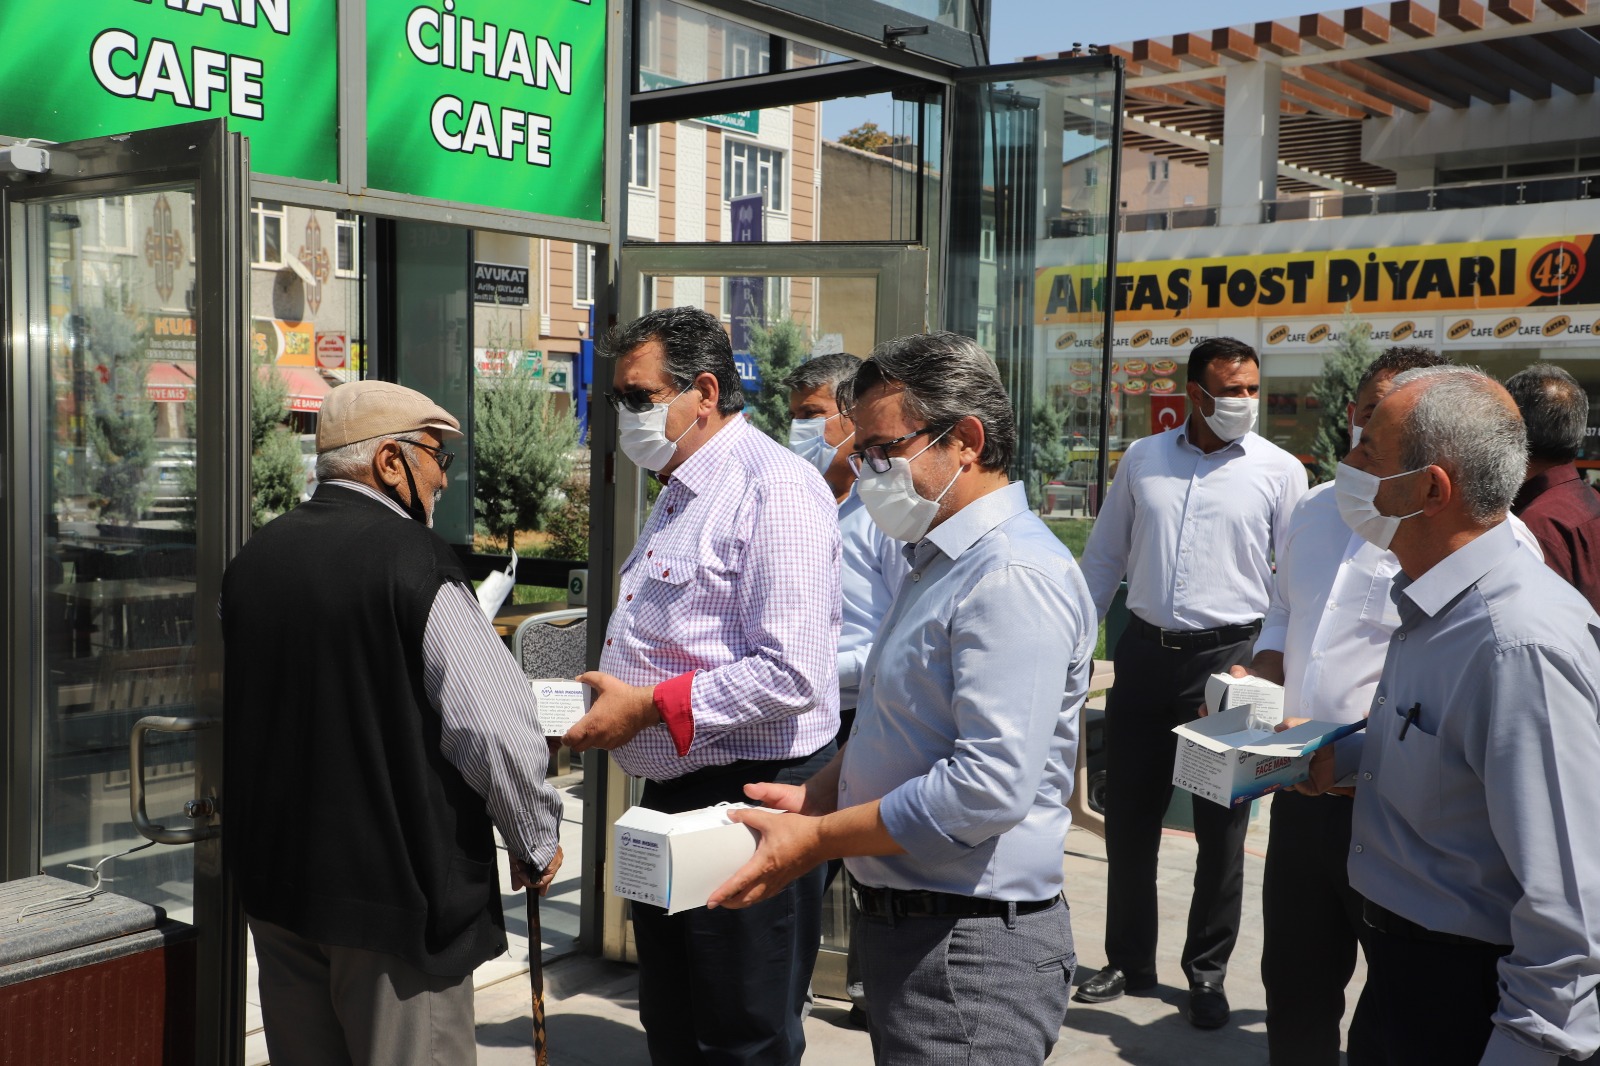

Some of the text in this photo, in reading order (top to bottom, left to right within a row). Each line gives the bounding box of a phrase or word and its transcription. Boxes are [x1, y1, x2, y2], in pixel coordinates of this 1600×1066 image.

[405, 0, 573, 95] CİHAN
[89, 28, 264, 121] CAFE
[429, 95, 552, 167] CAFE
[475, 266, 527, 283] AVUKAT
[1201, 260, 1315, 308] TOST
[1327, 247, 1517, 303] DİYARI
[1286, 333, 1306, 343] CAFE
[1370, 331, 1390, 340] CAFE
[1412, 329, 1434, 339] CAFE
[1470, 327, 1493, 337] CAFE
[1518, 325, 1541, 336] CAFE
[1567, 324, 1591, 334] CAFE
[1074, 339, 1092, 348] CAFE
[1150, 337, 1169, 346] CAFE
[573, 580, 580, 592] 2
[1255, 762, 1273, 776] FACE
[1273, 757, 1292, 770] MASK
